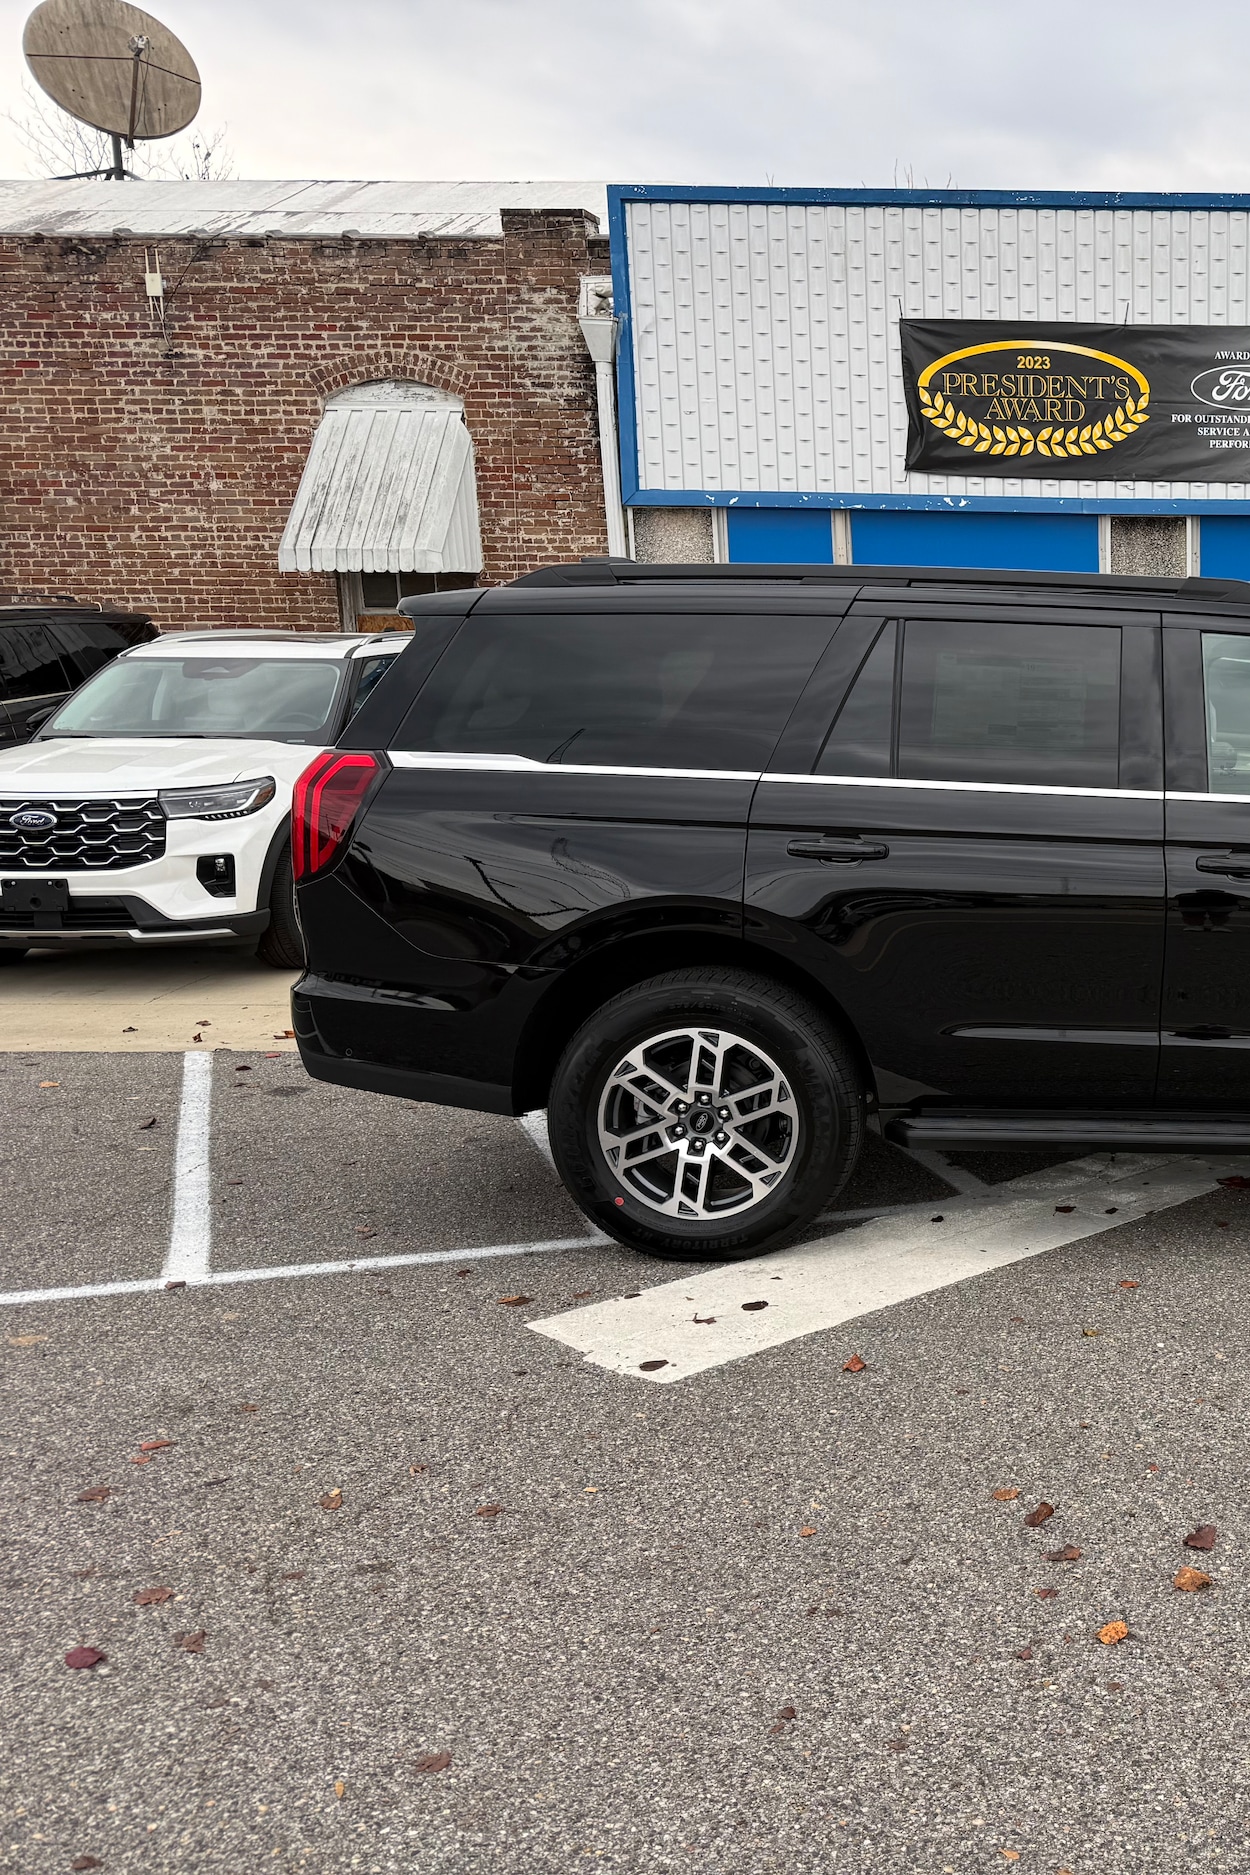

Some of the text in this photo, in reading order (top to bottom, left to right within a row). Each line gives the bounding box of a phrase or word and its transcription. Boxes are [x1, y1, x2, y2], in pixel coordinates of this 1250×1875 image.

[1016, 355, 1051, 370] 2023
[942, 372, 1131, 400] PRESIDENT'S
[983, 397, 1086, 422] AWARD
[1171, 413, 1192, 423] FOR
[1197, 426, 1241, 436] SERVICE
